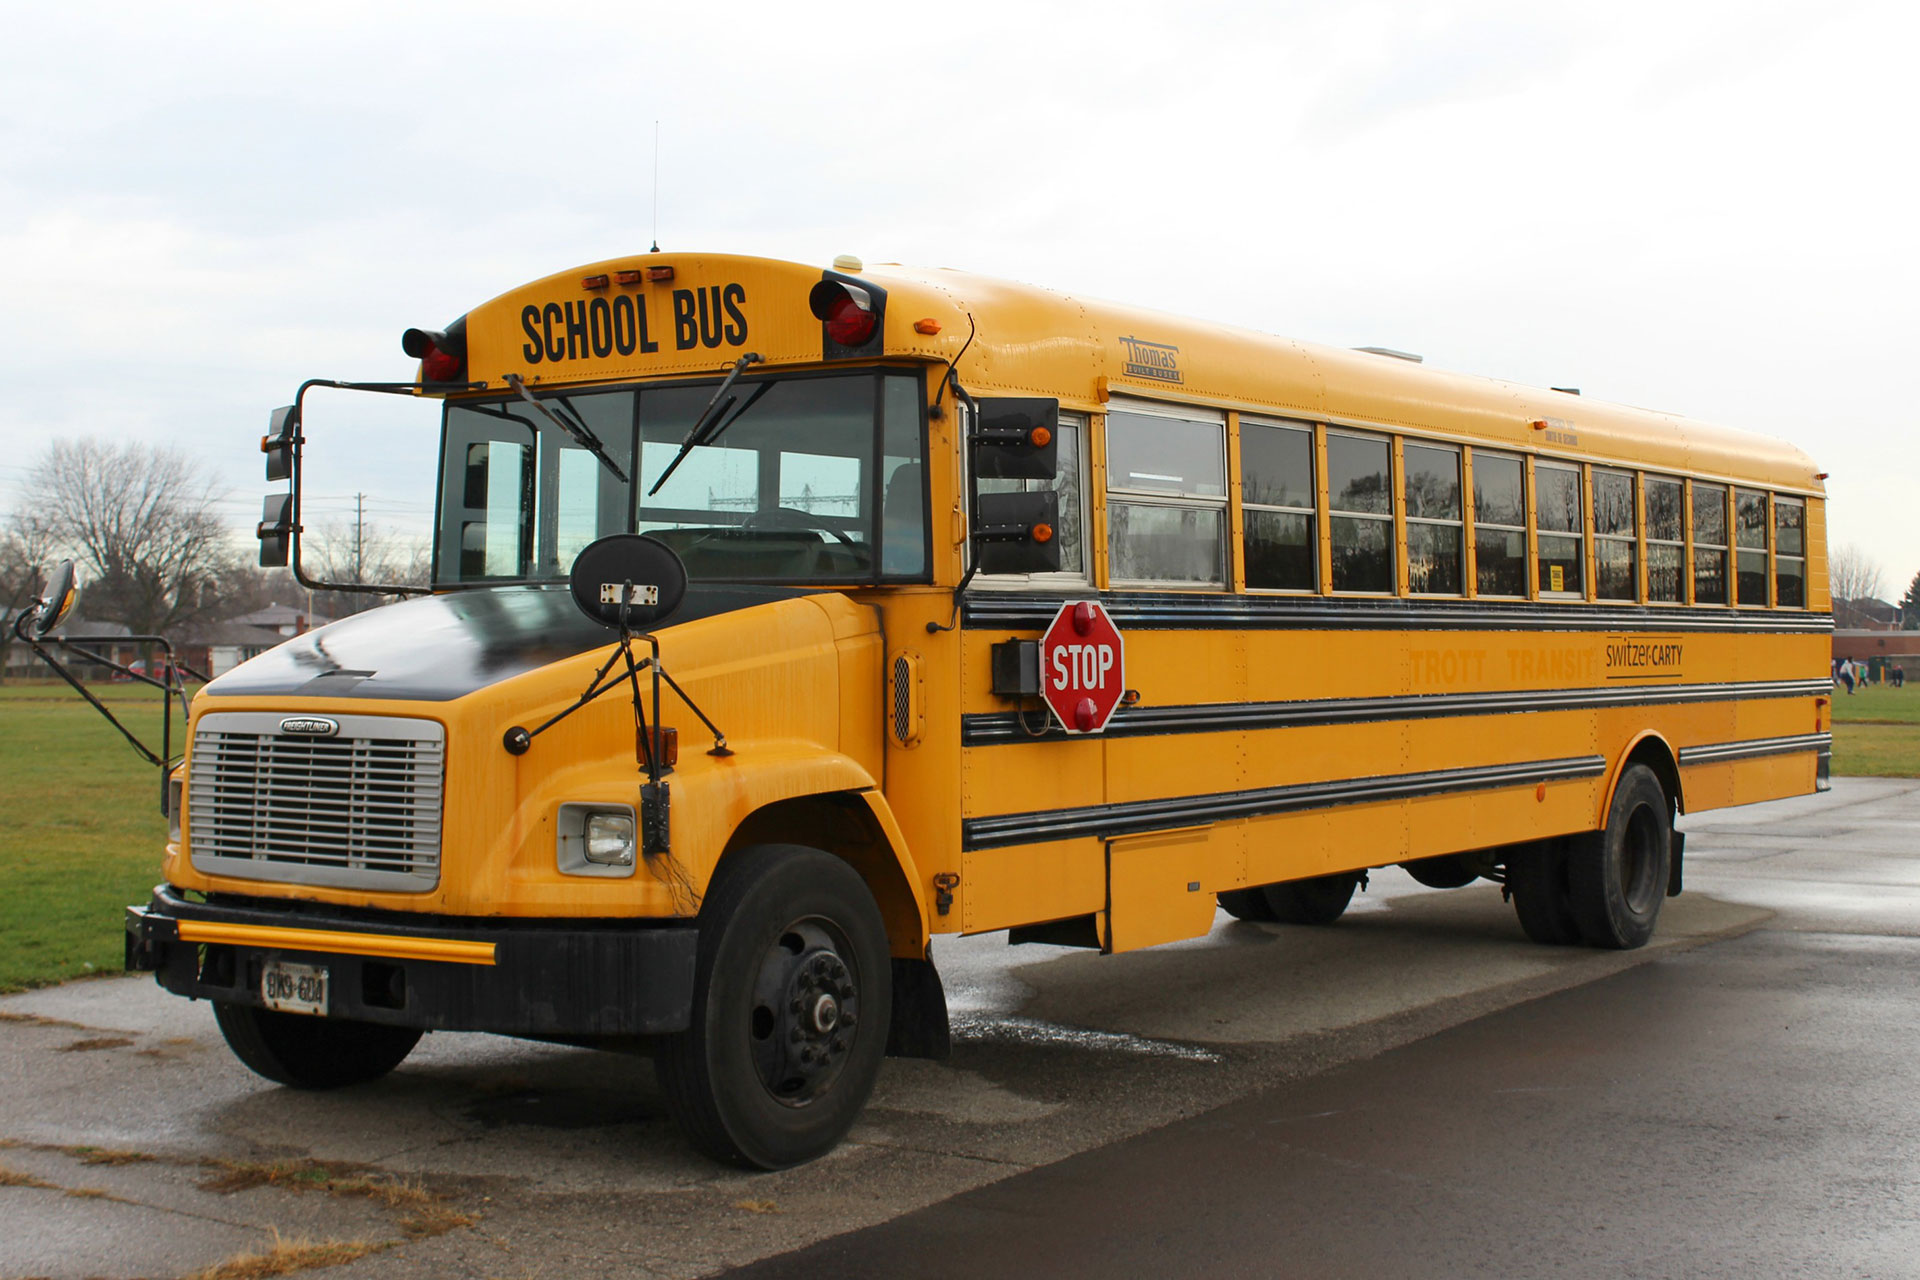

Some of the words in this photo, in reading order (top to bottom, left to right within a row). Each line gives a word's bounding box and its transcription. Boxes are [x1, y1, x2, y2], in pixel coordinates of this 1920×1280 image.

[521, 294, 658, 364] SCHOOL
[673, 283, 748, 350] BUS
[1118, 335, 1179, 369] Thomas
[1053, 644, 1113, 691] STOP
[1409, 649, 1487, 684] TROTT
[1507, 648, 1594, 681] TRANSIT
